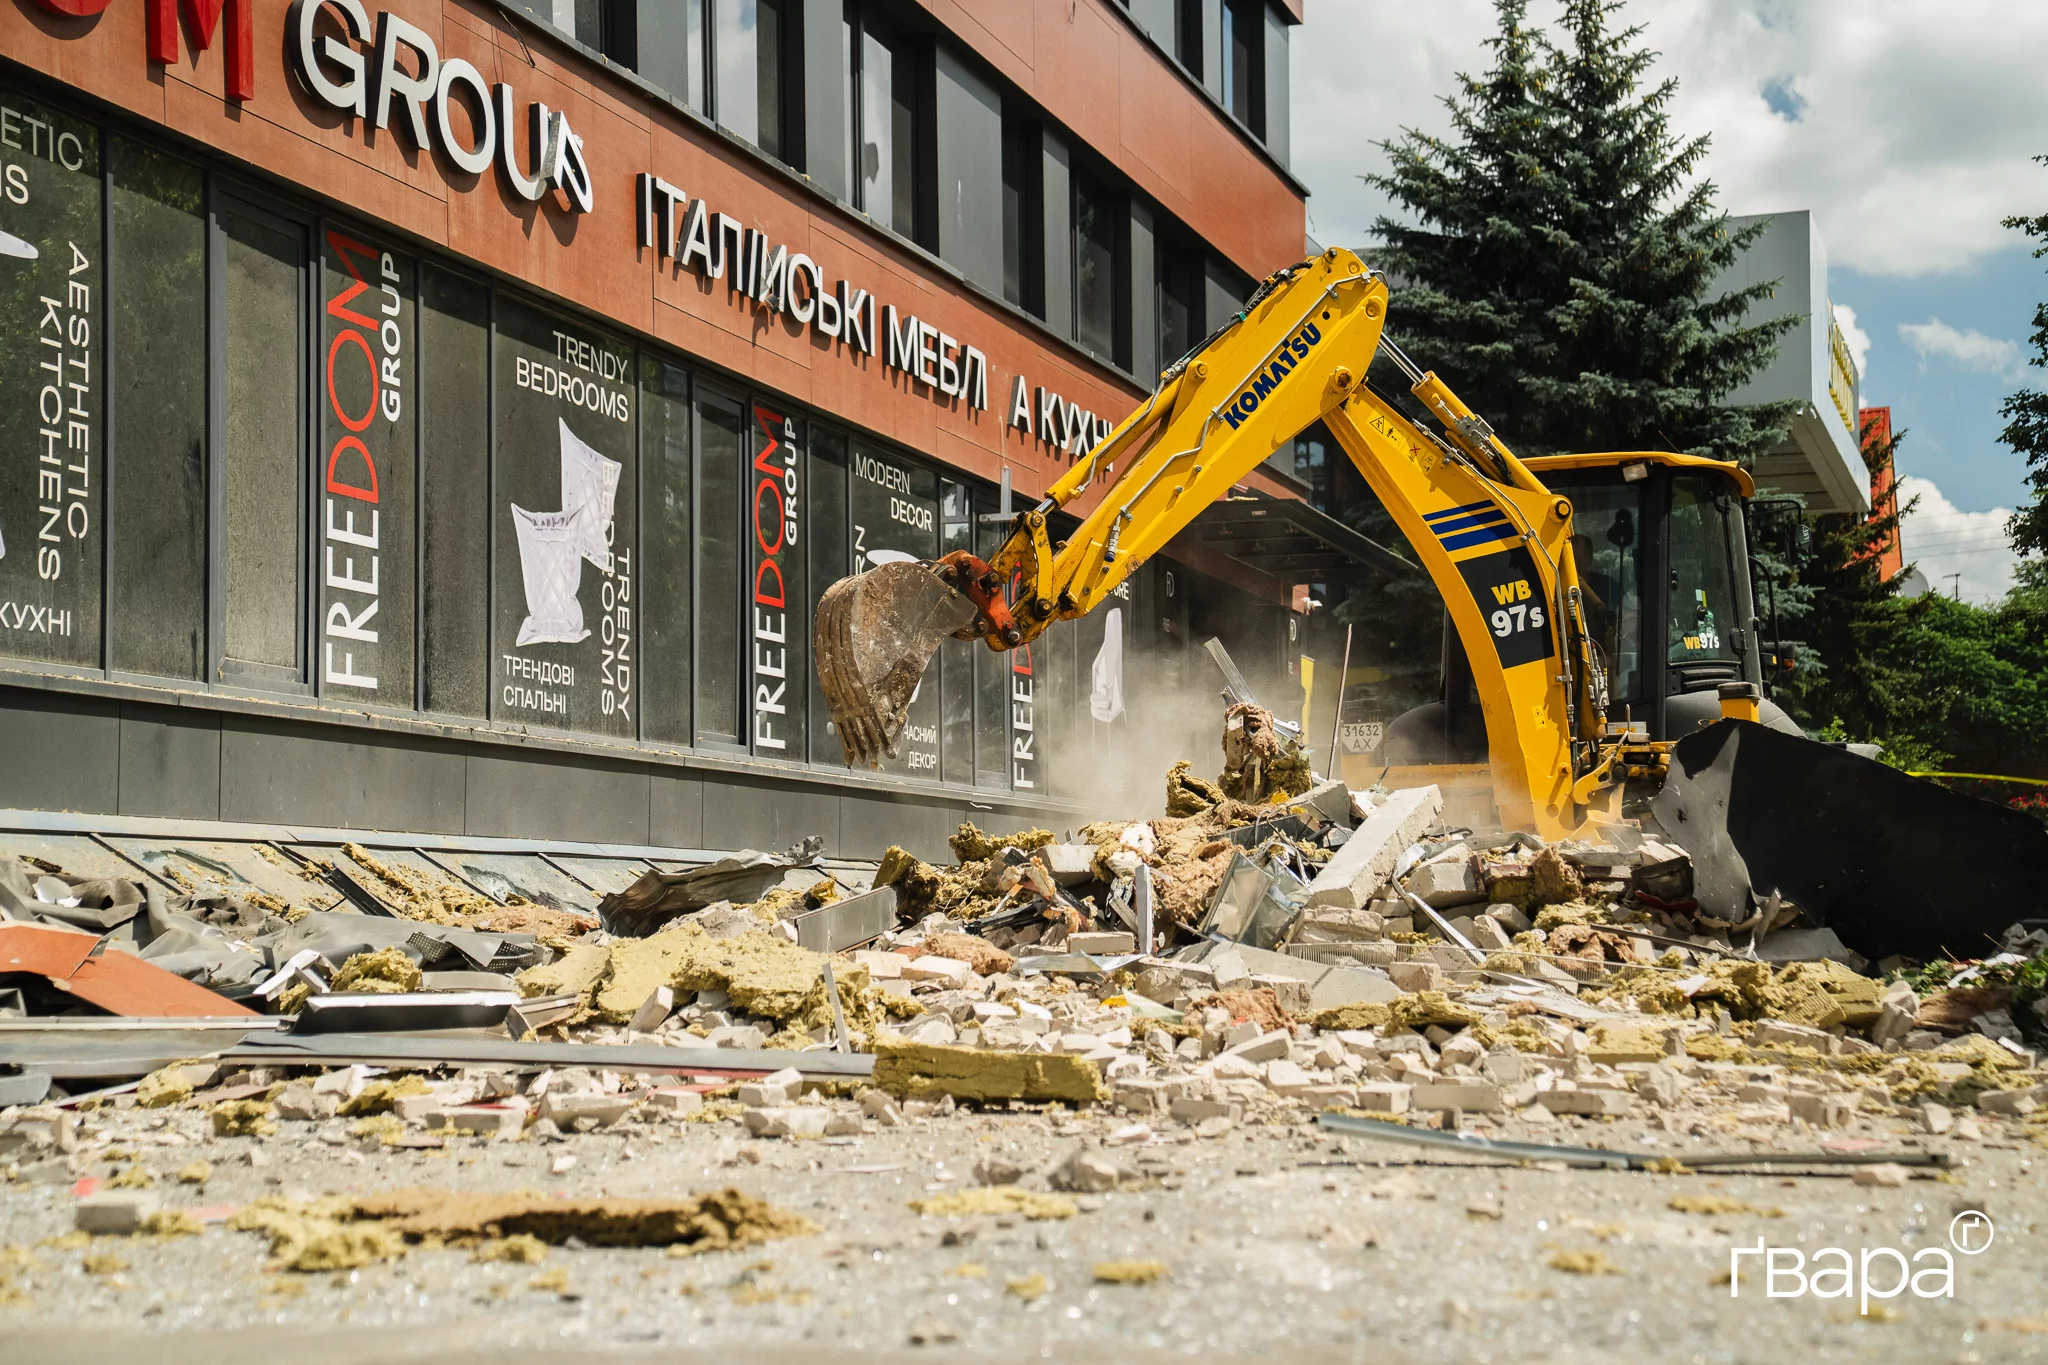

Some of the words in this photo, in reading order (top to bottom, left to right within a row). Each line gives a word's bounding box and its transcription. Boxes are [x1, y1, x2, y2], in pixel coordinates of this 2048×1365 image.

[381, 251, 401, 422] GROUP
[552, 330, 628, 385] TRENDY
[1223, 322, 1322, 431] KOMATSU
[68, 240, 89, 540] AESTHETIC
[516, 356, 629, 423] BEDROOMS
[38, 295, 62, 581] KITCHENS
[325, 229, 379, 689] FREEDOM
[784, 416, 797, 546] GROUP
[855, 452, 911, 495] MODERN
[890, 496, 933, 533] DECOR
[754, 405, 786, 750] FREEDOM
[1490, 580, 1532, 606] WB
[502, 654, 575, 687] ТРЕНДОВІ
[616, 547, 630, 722] TRENDY
[1012, 560, 1034, 789] FREED
[502, 685, 567, 715] СПАЛЬНІ
[1344, 724, 1379, 737] 31632
[907, 751, 937, 770] ДЕКОР
